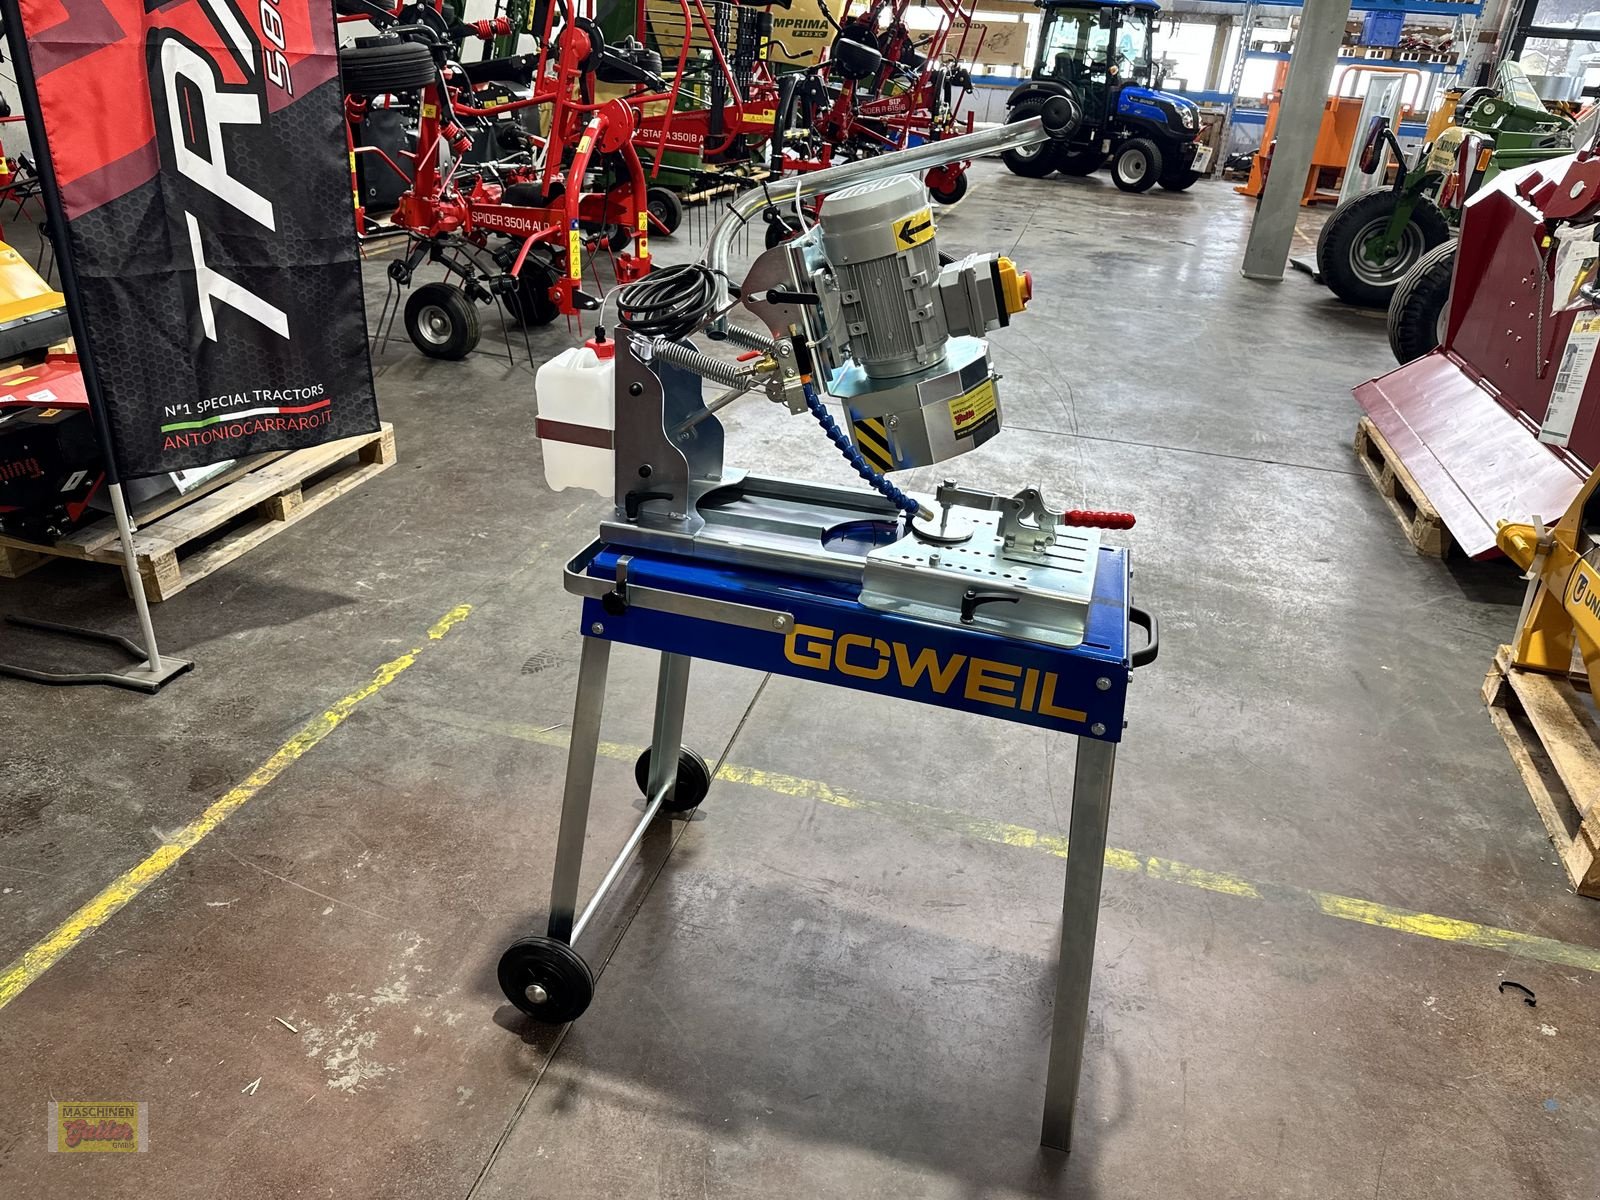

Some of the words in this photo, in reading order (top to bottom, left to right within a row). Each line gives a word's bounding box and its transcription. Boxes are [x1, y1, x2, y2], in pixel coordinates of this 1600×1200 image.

[260, 0, 294, 97] 58
[472, 211, 503, 226] SPIDER
[197, 392, 251, 413] SPECIAL
[252, 383, 325, 401] TRACTORS
[164, 409, 333, 450] ANTONIOCARRARO.IT
